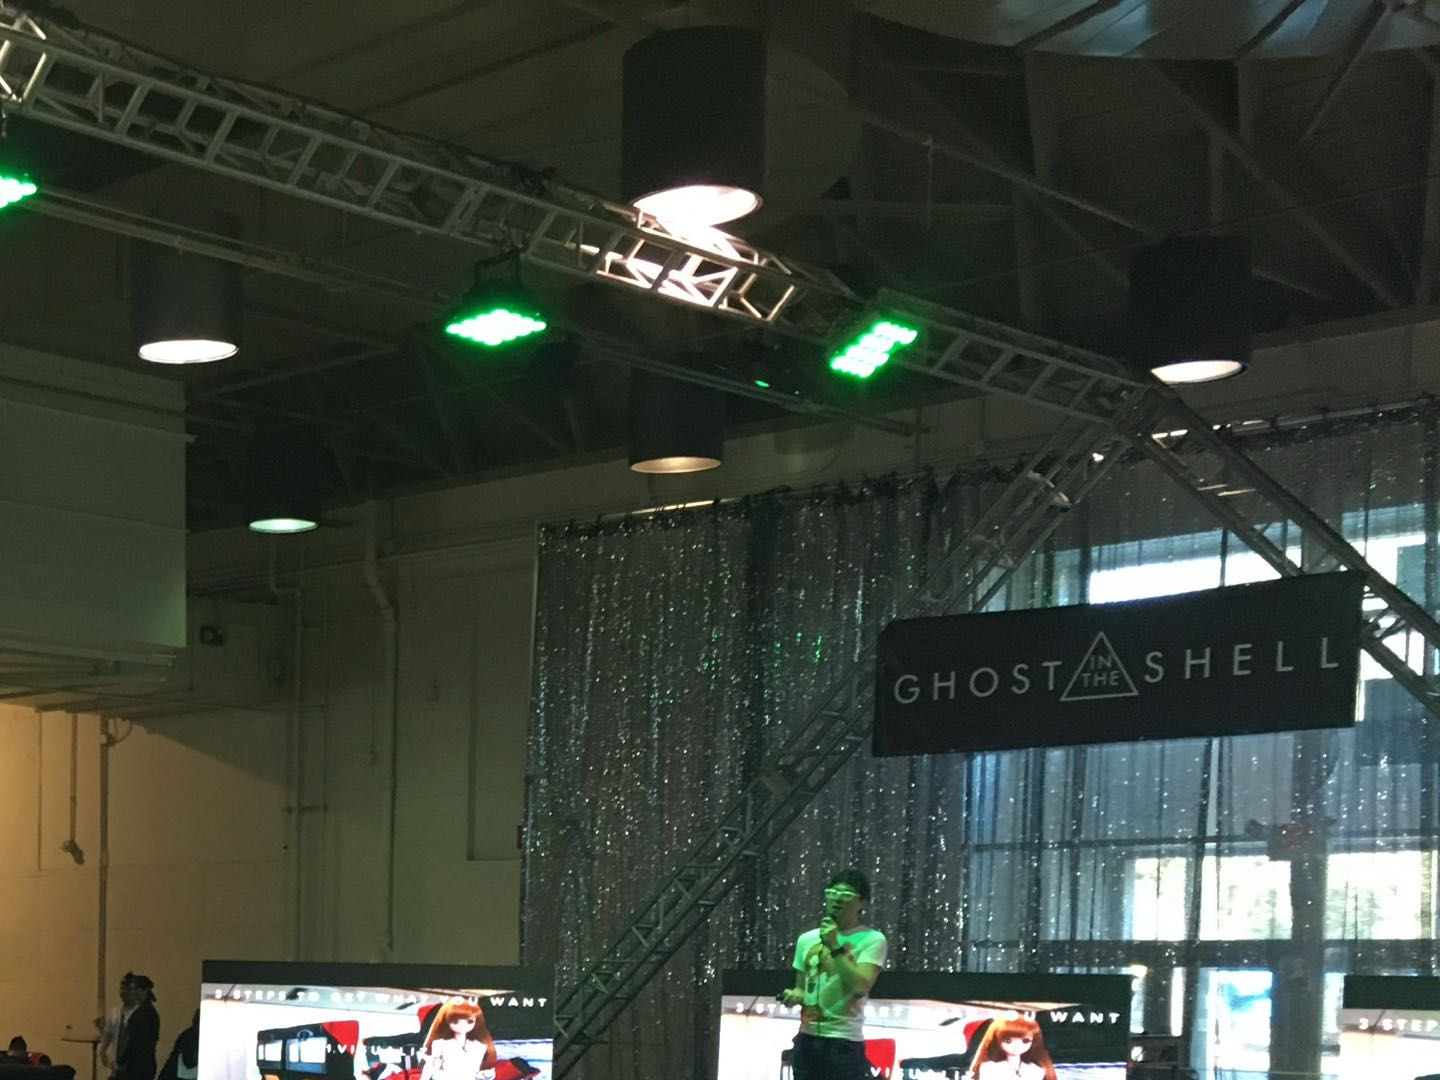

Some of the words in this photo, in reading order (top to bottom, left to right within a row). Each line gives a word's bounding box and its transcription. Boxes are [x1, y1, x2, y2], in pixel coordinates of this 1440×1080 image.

[894, 660, 1062, 705] GHOST
[1144, 637, 1341, 684] SHELL
[1090, 654, 1113, 671] IN
[1080, 670, 1120, 689] THE
[232, 990, 287, 1002] STEPS
[297, 992, 320, 1003] TO
[330, 992, 366, 1004] GET
[375, 994, 428, 1005] WHAT
[439, 994, 479, 1006] YOU
[490, 996, 547, 1008] WANT
[756, 1003, 802, 1015] STEP
[1050, 1011, 1120, 1024] WANT
[1358, 1017, 1369, 1030] 3
